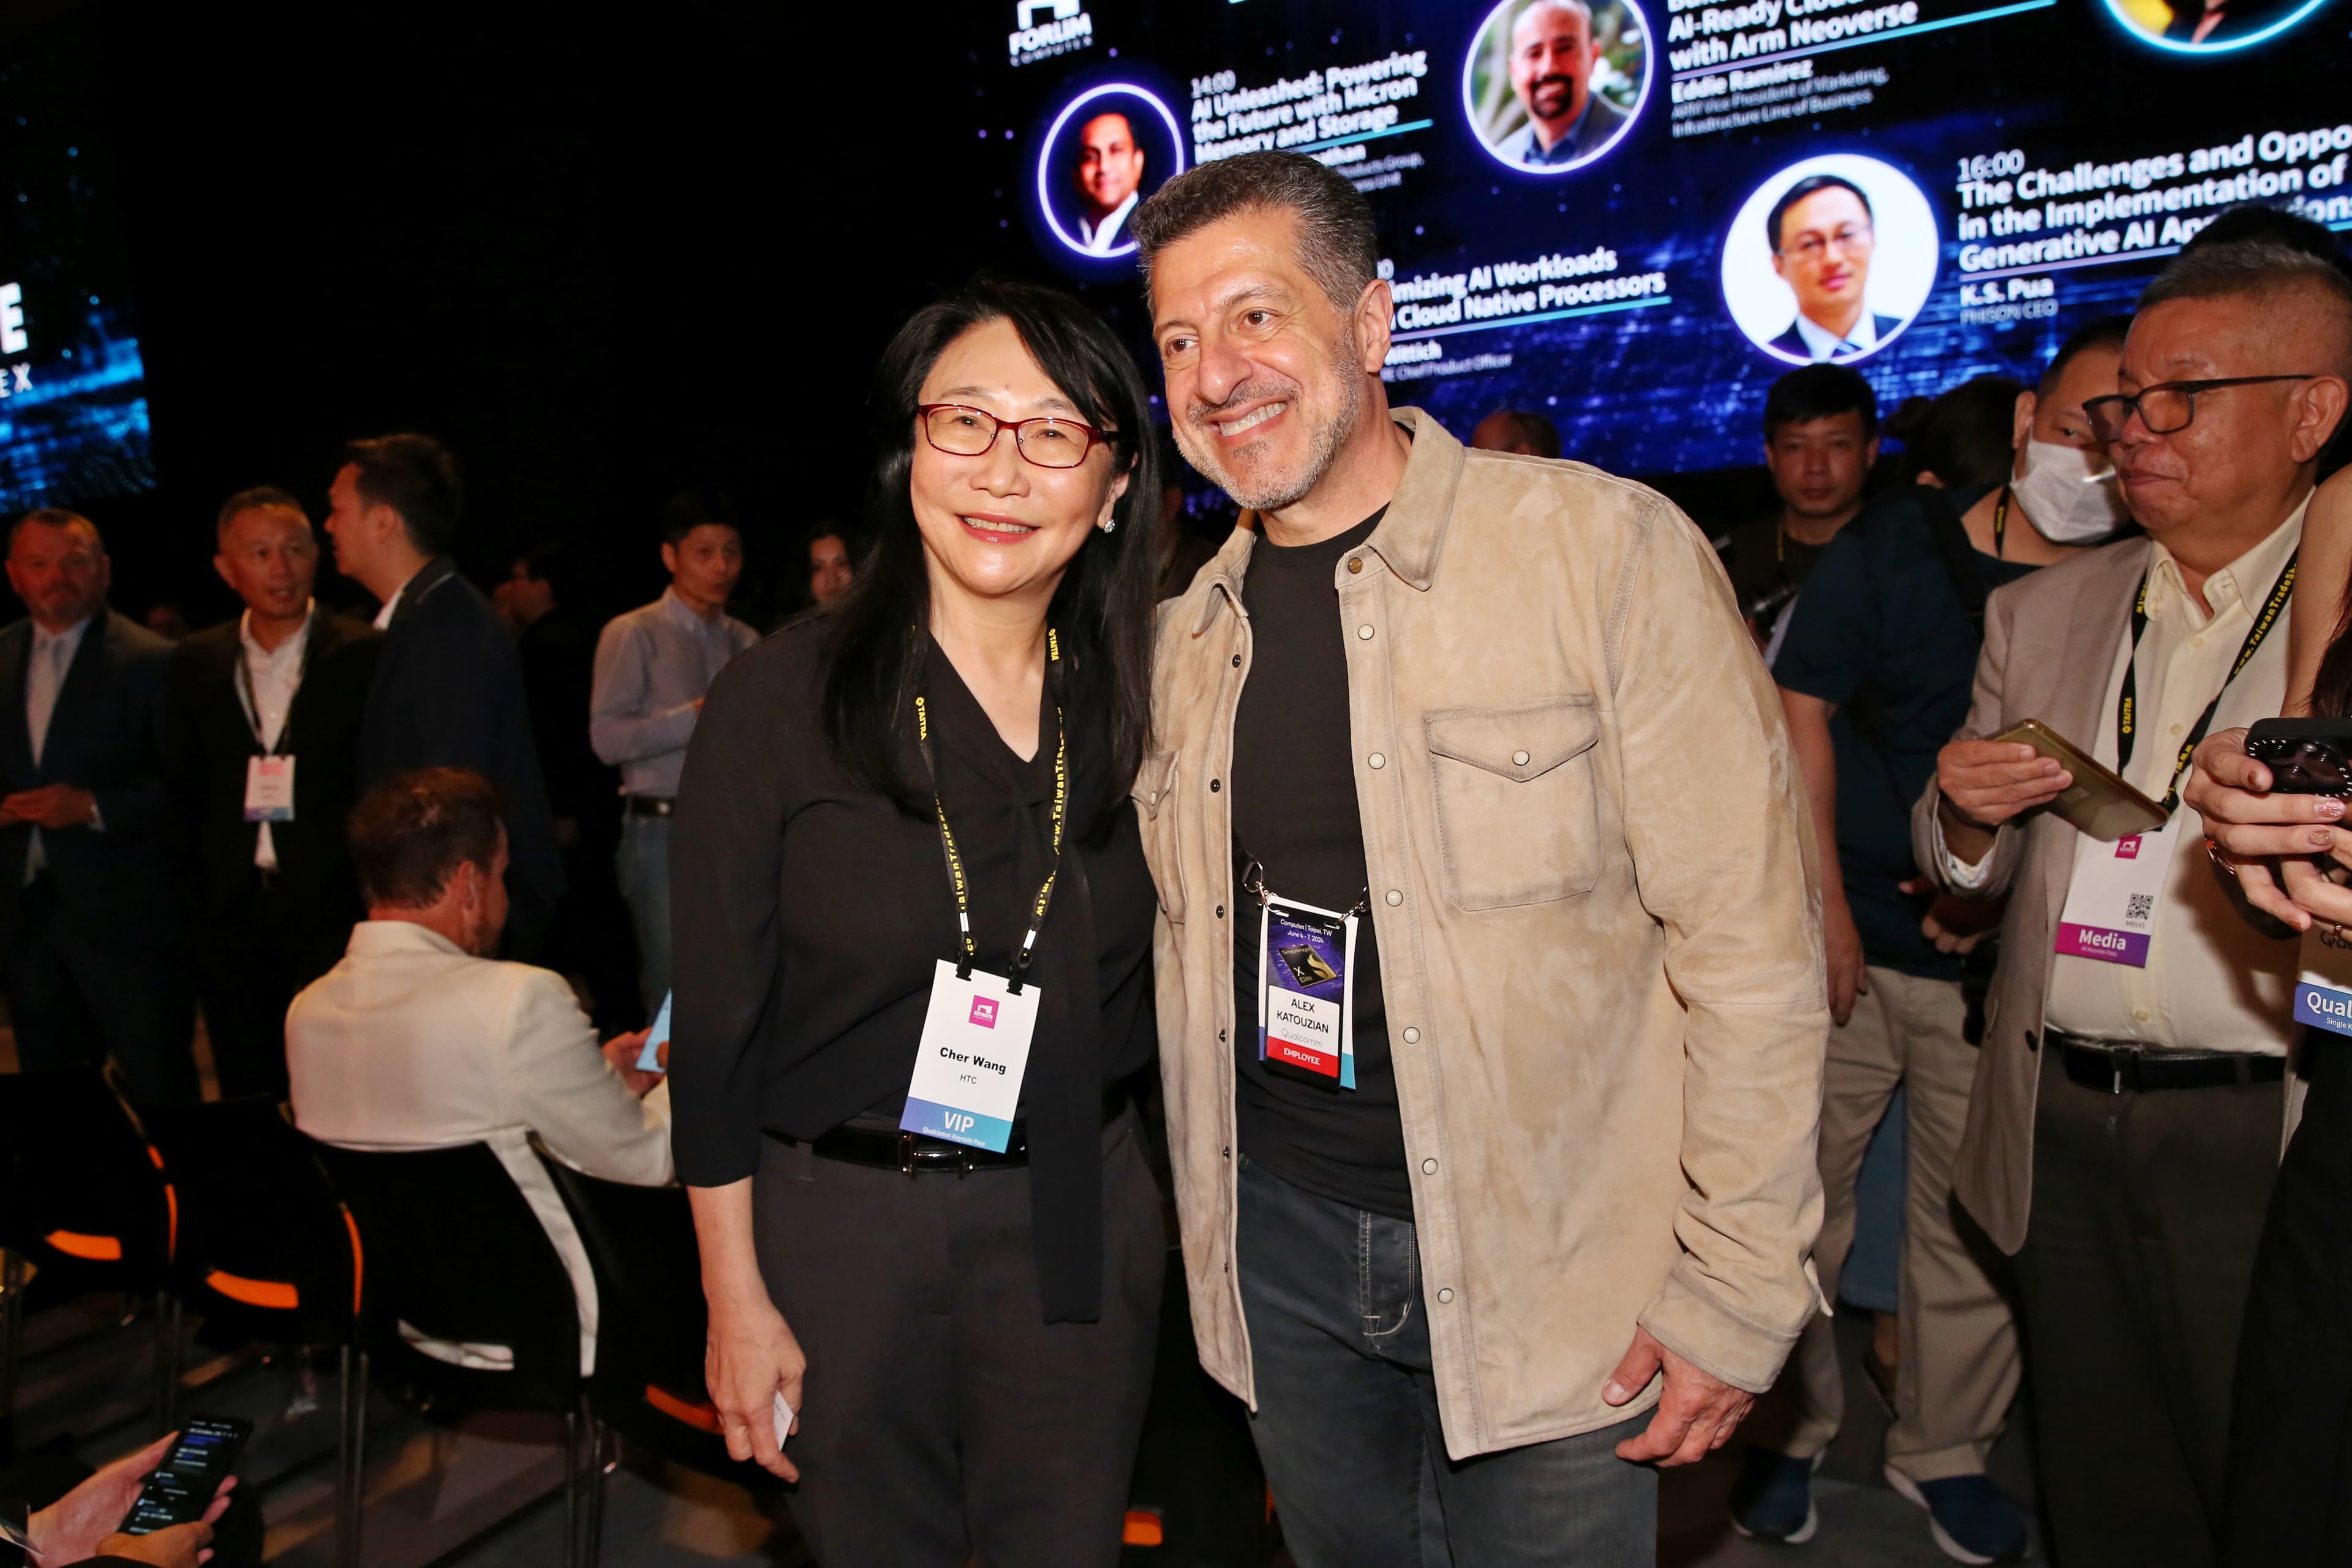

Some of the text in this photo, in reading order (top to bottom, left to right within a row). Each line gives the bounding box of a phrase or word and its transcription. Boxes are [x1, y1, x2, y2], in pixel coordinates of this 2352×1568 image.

[1009, 12, 1092, 56] FORUM
[1667, 0, 1783, 42] AI-Ready
[1668, 1, 1919, 71] with Arm Neoverse
[1191, 70, 1237, 99] 14:00
[1192, 51, 1428, 122] AI Unleashed: Powering
[1671, 59, 1814, 104] Eddie Ramirez
[1797, 78, 1813, 97] of
[1193, 77, 1419, 144] the Future with Micron
[1761, 104, 1792, 122] Line
[1792, 97, 1808, 116] of
[1194, 104, 1399, 165] Memory and Storage
[1956, 124, 2352, 209] The Challenges and Oppo
[1957, 149, 2025, 183] 16:00
[1958, 213, 1988, 241] in
[1990, 206, 2042, 236] the
[2045, 167, 2304, 229] Implementation
[2307, 153, 2350, 189] of
[1959, 219, 2155, 273] Generative AI
[1469, 266, 1492, 292] AI
[1493, 246, 1618, 287] Workloads
[1397, 299, 1462, 330] Cloud
[1464, 290, 1537, 319] Native
[1539, 271, 1667, 309] Processors
[1960, 277, 2054, 306] K.S. Pua
[2022, 298, 2059, 319] CEO
[1049, 634, 1060, 662] TAITRA
[918, 705, 927, 741] TAITRA
[1280, 919, 1305, 930] Computex
[1287, 930, 1299, 938] June
[1311, 935, 1324, 944] 2024
[2079, 929, 2127, 951] Media
[1293, 966, 1305, 977] X
[1291, 998, 1315, 1013] ALEX
[2307, 991, 2352, 1019] Qual
[1277, 1011, 1329, 1034] KATOUZIAN
[2326, 1017, 2347, 1029] Single
[1281, 1028, 1323, 1048] Qualcomm
[940, 1047, 1006, 1075] Cher Wang
[1283, 1047, 1321, 1066] EMPLOYEE
[960, 1074, 977, 1084] HTC
[922, 1126, 952, 1138] Qualcomm
[944, 1111, 974, 1133] VIP
